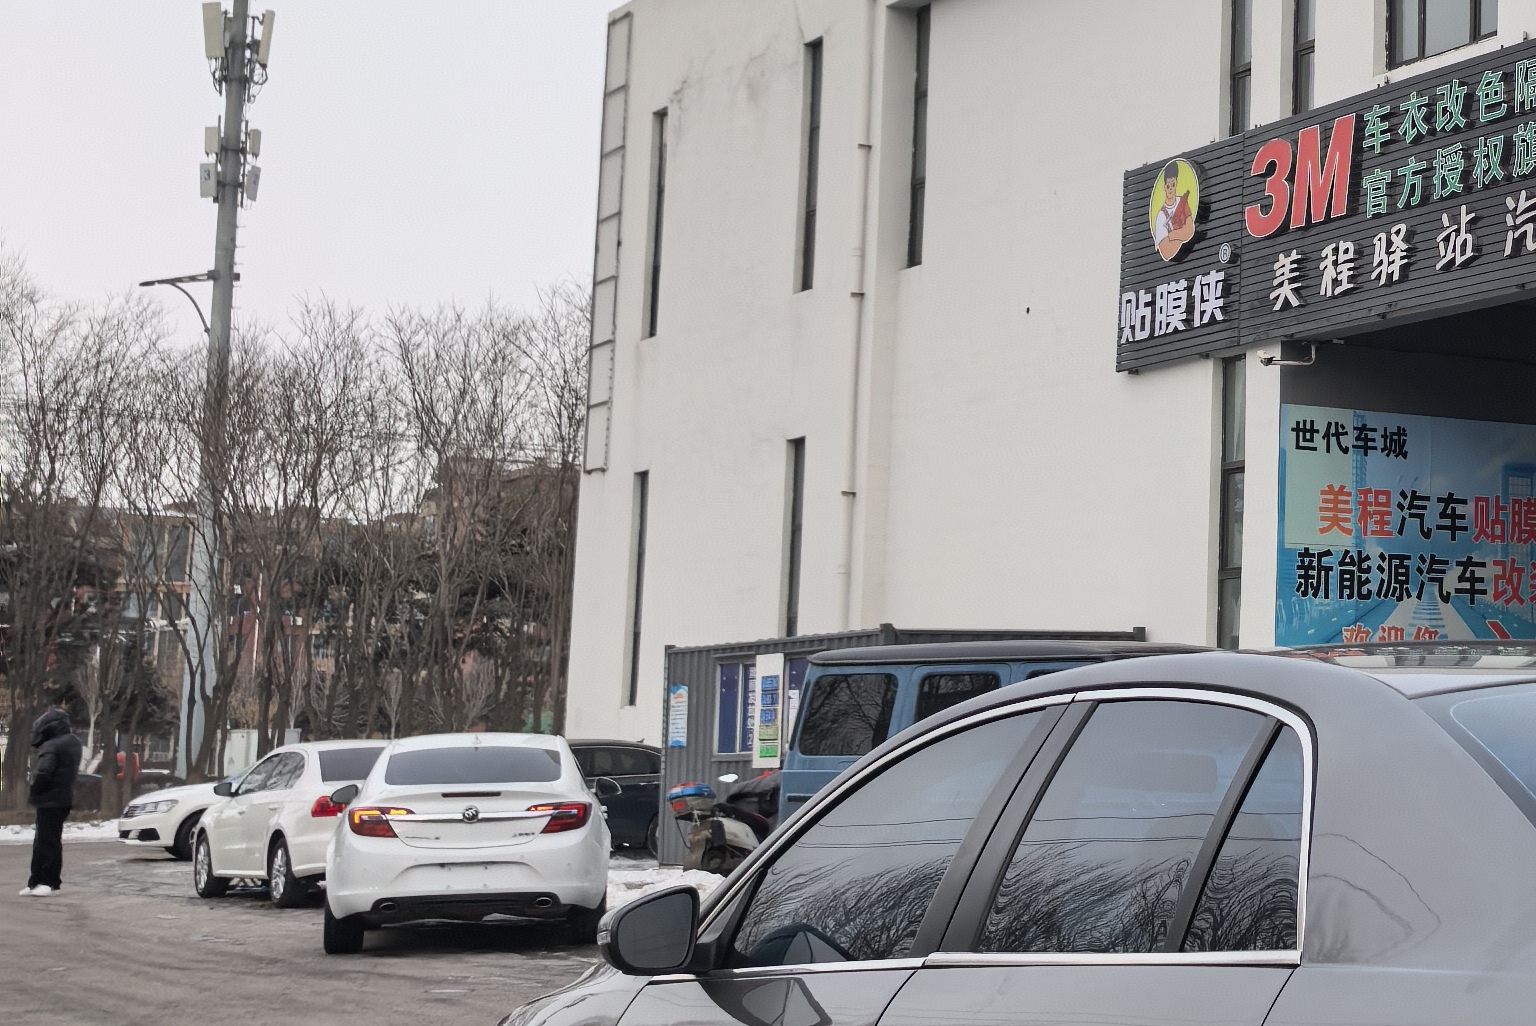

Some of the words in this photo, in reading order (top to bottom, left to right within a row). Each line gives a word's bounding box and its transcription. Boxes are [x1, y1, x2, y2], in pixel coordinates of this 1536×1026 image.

[1244, 114, 1357, 239] 3M
[1120, 269, 1225, 344] 贴膜侠
[1290, 418, 1409, 460] 世代车城
